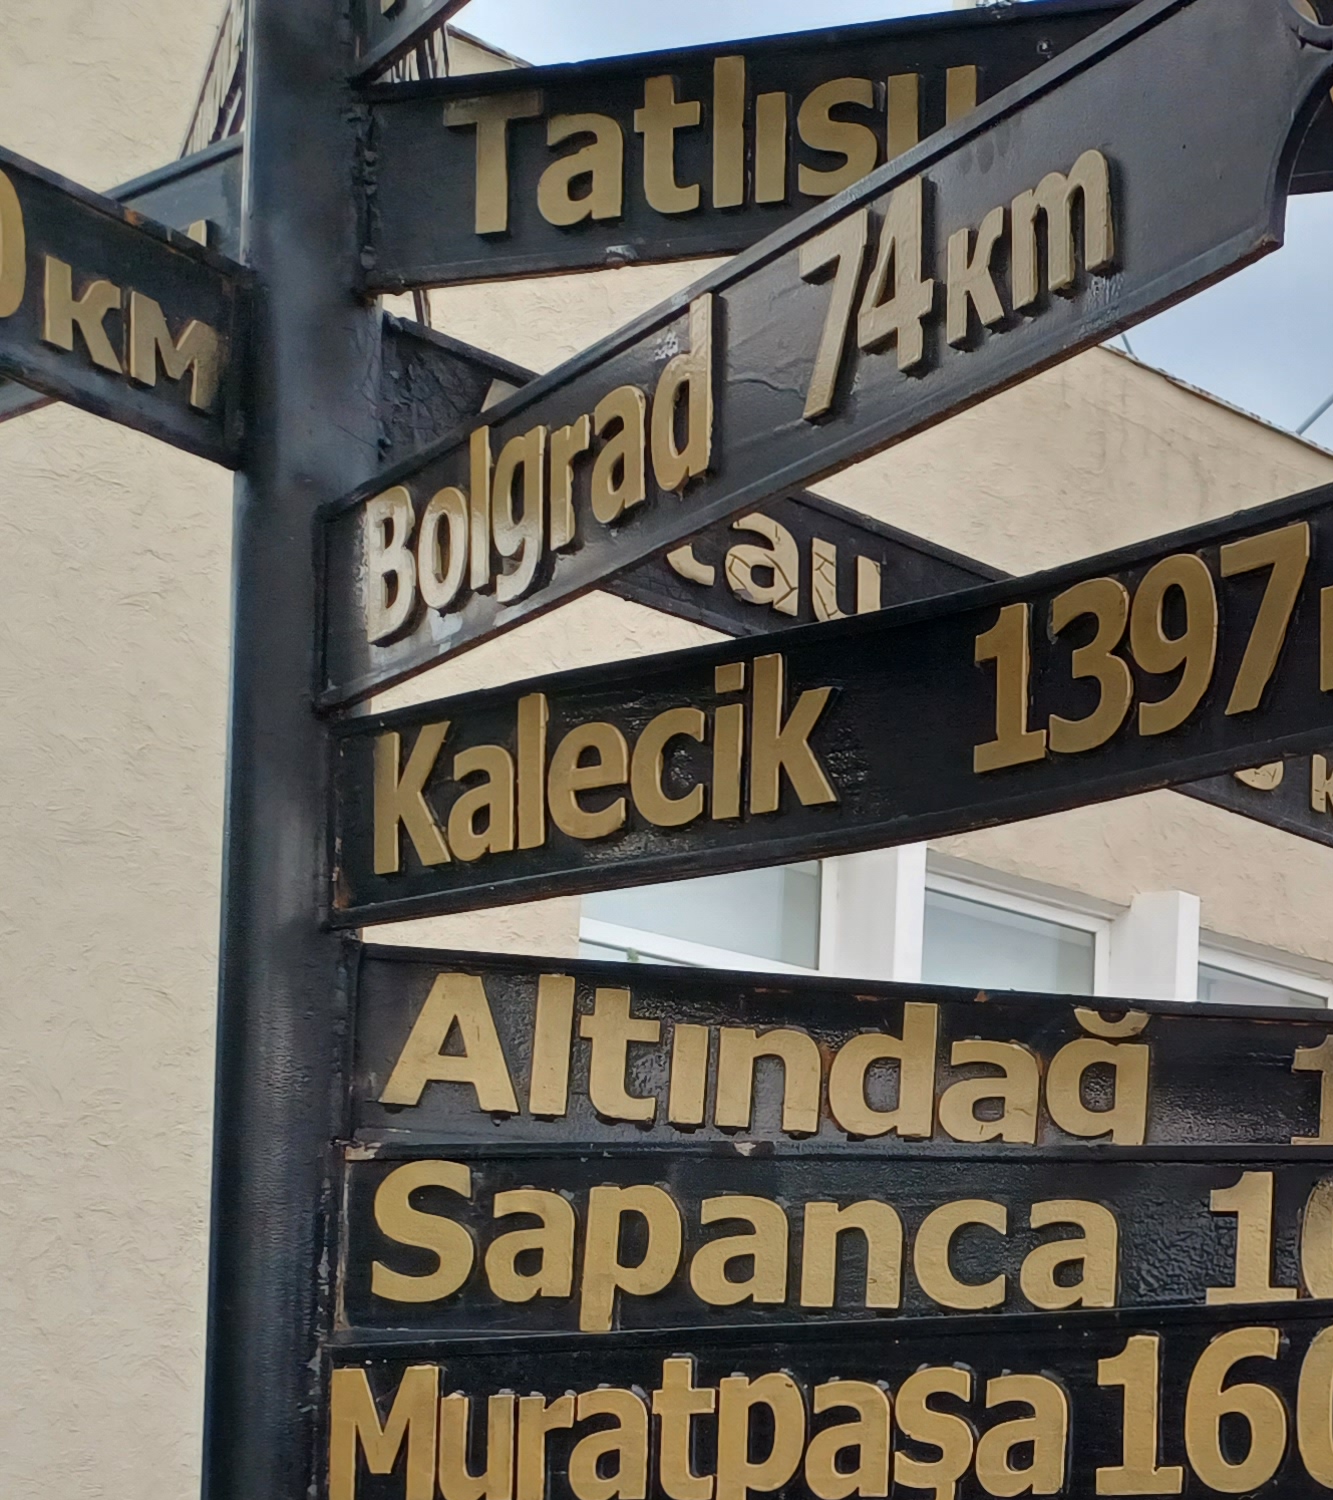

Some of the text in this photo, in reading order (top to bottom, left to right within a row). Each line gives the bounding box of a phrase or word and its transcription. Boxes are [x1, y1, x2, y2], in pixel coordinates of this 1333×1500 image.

[364, 149, 1114, 645] Bolgrad 74 km
[373, 653, 839, 875] Kalecik
[973, 521, 1311, 774] 1397
[377, 972, 1150, 1146] Altındağ
[372, 1160, 1119, 1331] Sapanca
